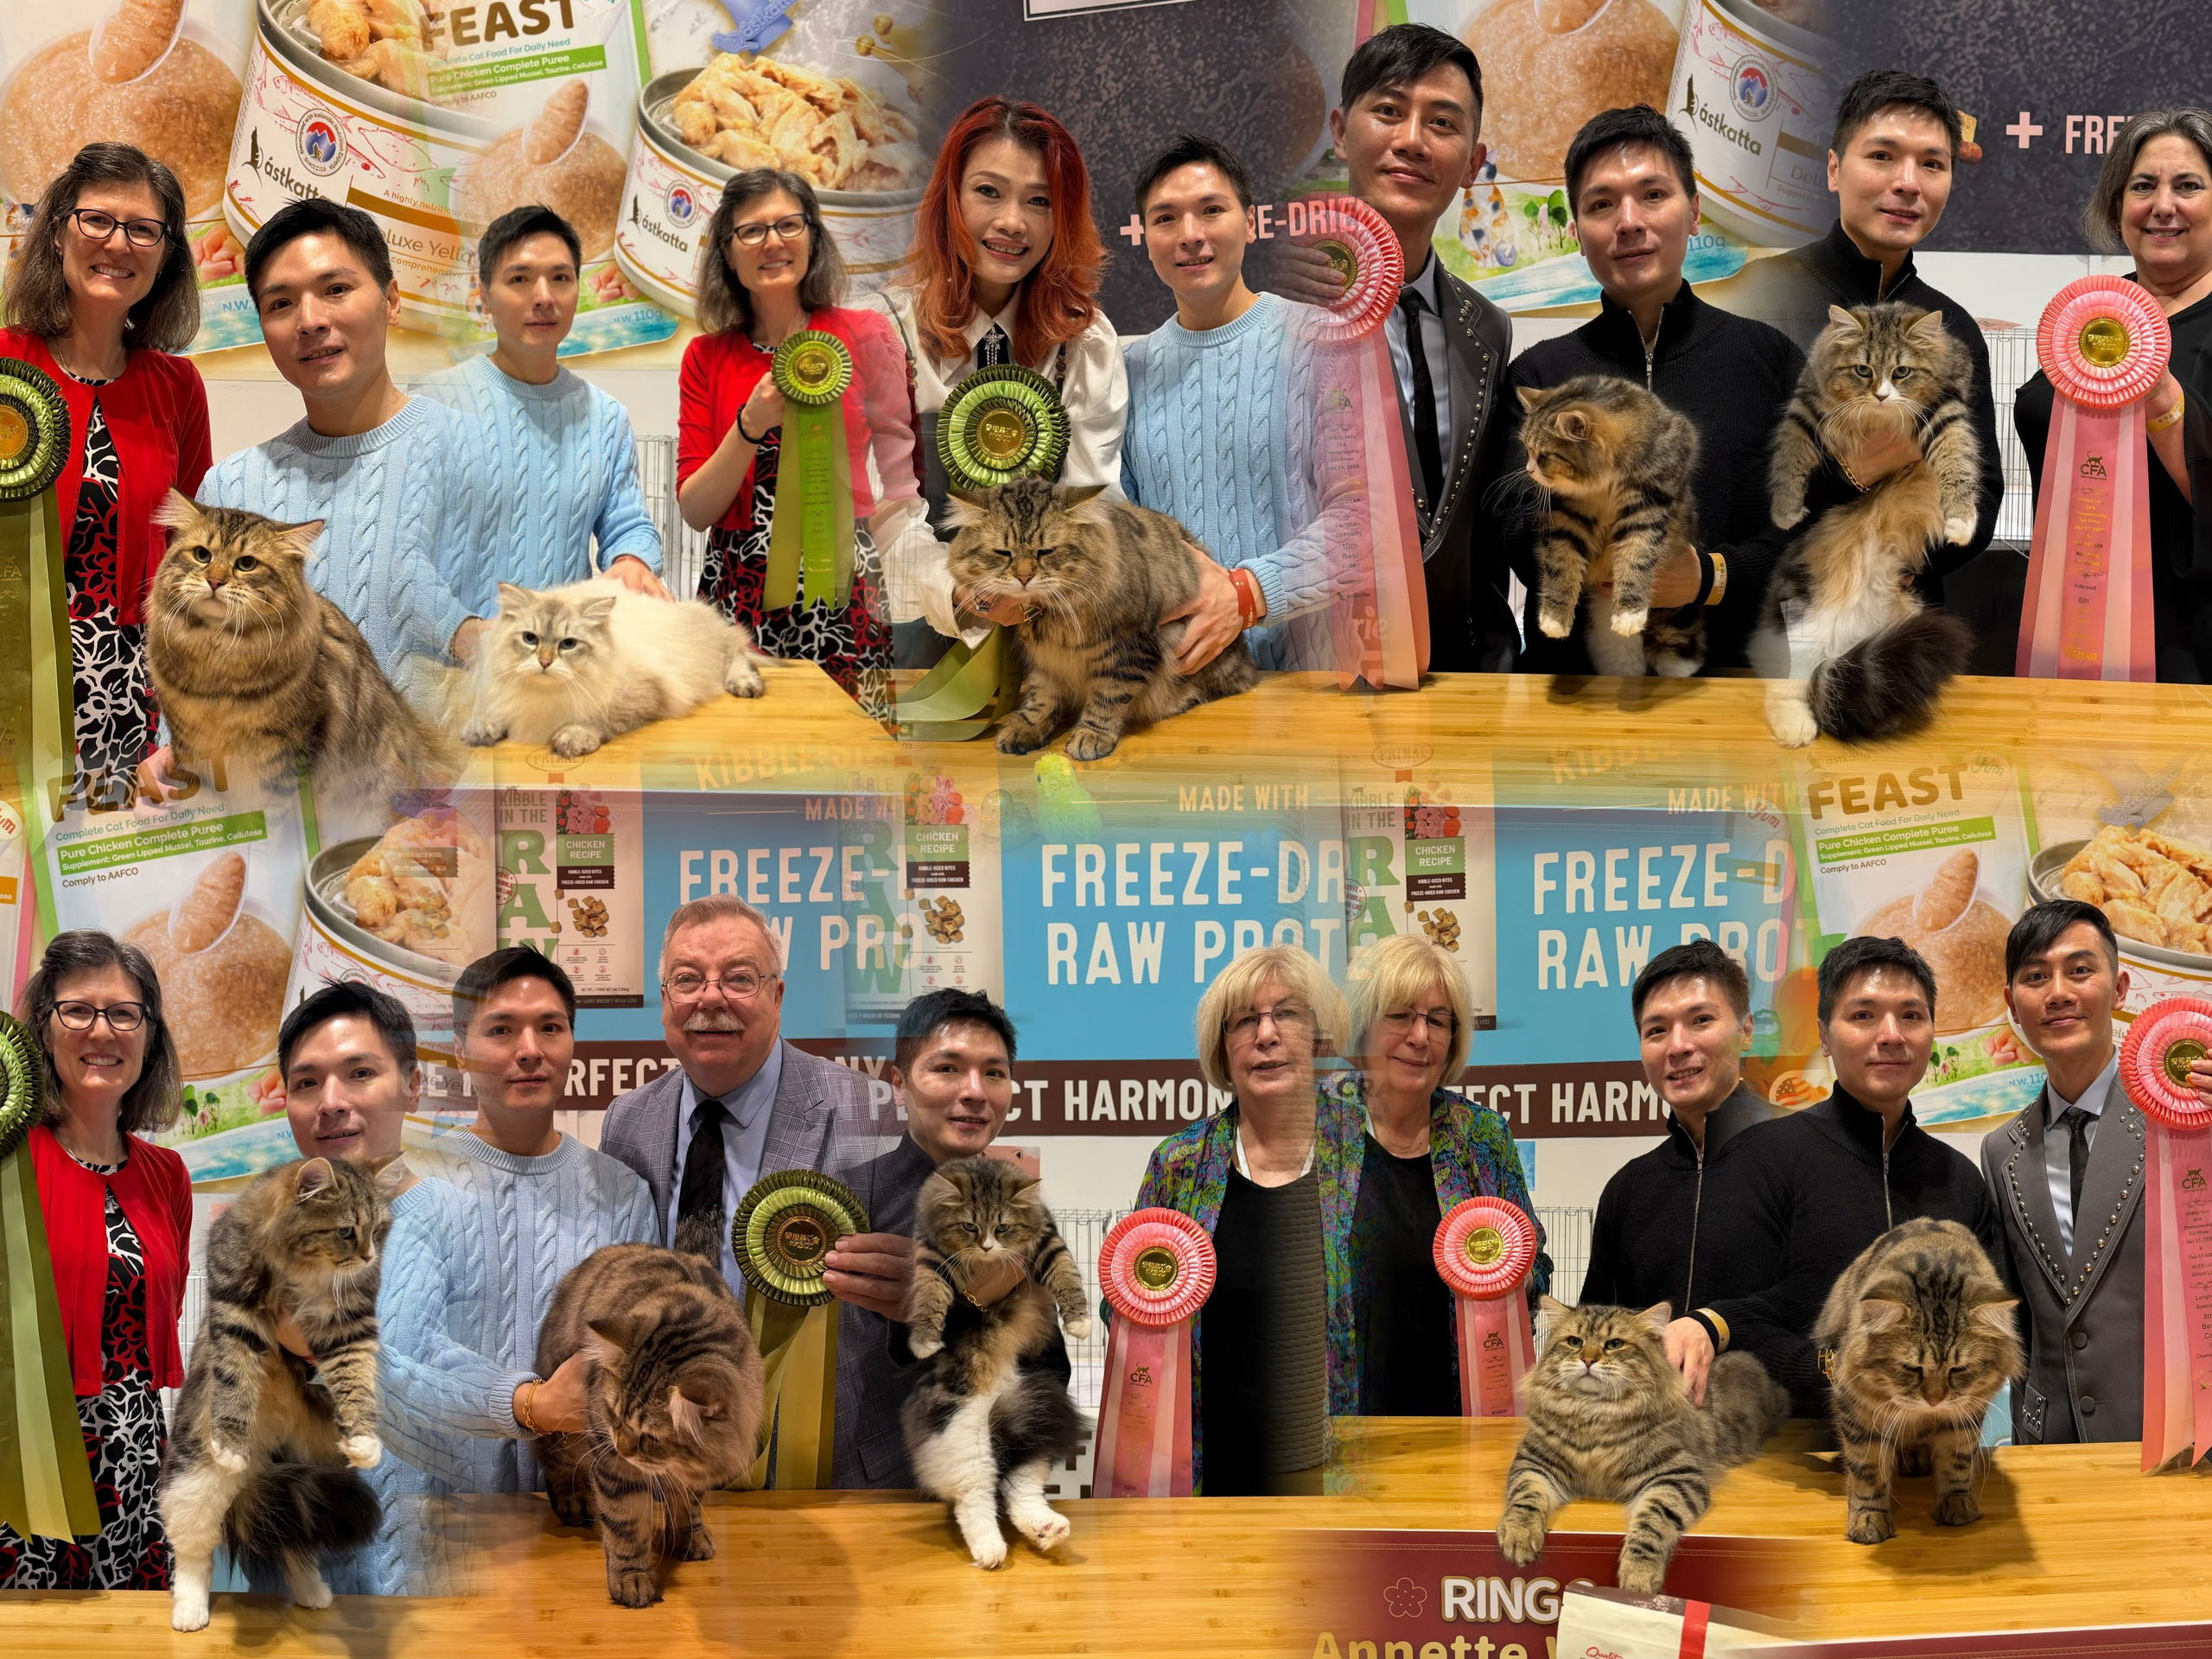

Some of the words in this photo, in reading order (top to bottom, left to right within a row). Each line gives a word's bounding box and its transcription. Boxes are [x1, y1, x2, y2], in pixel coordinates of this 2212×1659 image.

[420, 0, 574, 51] FEAST
[426, 56, 467, 68] Complete
[469, 52, 484, 61] Cat
[486, 48, 507, 58] Food
[509, 46, 522, 54] For
[524, 42, 545, 53] Daily
[548, 38, 570, 48] Need
[430, 73, 452, 83] Pure
[454, 64, 491, 79] Chicken
[493, 58, 540, 73] Complete
[542, 54, 569, 66] Puree
[474, 76, 494, 86] Green
[495, 73, 518, 84] Lipped
[572, 60, 603, 70] Cellulose
[471, 91, 497, 101] AAFCO
[1700, 103, 1762, 156] ástkatta
[2065, 115, 2133, 154] FRE
[391, 191, 417, 207] highly
[420, 201, 461, 216] nutritious
[1254, 199, 1357, 240] E-DRIE
[642, 215, 688, 252] ástkatta
[391, 257, 463, 279] comprehensive
[2080, 464, 2107, 476] CFA
[2075, 652, 2097, 660] ZERO
[1379, 746, 1426, 760] PRIMAL
[499, 792, 547, 806] KIBBLE
[1178, 785, 1244, 812] MADE
[1255, 784, 1309, 810] WITH
[1345, 792, 1395, 811] KIBBLE
[1668, 785, 1732, 815] MADE
[1807, 763, 1968, 821] FEAST
[55, 826, 104, 842] Complete
[105, 822, 124, 833] Cat
[126, 817, 150, 829] Food
[153, 813, 168, 824] For
[171, 808, 196, 820] Daily
[198, 803, 225, 816] Need
[499, 810, 513, 823] IN
[520, 809, 547, 823] THE
[805, 798, 865, 821] MADE
[1347, 813, 1361, 830] IN
[1367, 811, 1395, 829] THE
[1815, 823, 1856, 836] Complete
[1858, 821, 1873, 830] Cat
[1876, 817, 1897, 827] Food
[1914, 812, 1935, 823] Daily
[1937, 809, 1960, 818] Need
[60, 848, 86, 860] Pure
[88, 837, 132, 855] Chicken
[135, 830, 188, 849] Complete
[191, 823, 224, 836] Puree
[566, 840, 605, 849] CHICKEN
[916, 832, 959, 842] CHICKEN
[920, 844, 956, 854] RECIPE
[1415, 845, 1455, 855] CHICKEN
[1819, 842, 1840, 851] Pure
[1843, 834, 1881, 848] Chicken
[1883, 829, 1929, 842] Complete
[1931, 825, 1959, 835] Puree
[1821, 849, 1863, 861] Supplement:
[1864, 845, 1884, 855] Green
[1885, 842, 1908, 852] Lipped
[1909, 838, 1934, 848] Mussel,
[1962, 830, 1992, 841] Cellulose
[62, 856, 111, 872] Supplement:
[112, 851, 136, 862] Green
[137, 847, 163, 860] Lipped
[165, 842, 194, 853] Mussel,
[227, 829, 263, 842] Cellulose
[1420, 856, 1452, 867] RECIPE
[62, 874, 95, 889] Comply
[97, 874, 106, 882] to
[108, 868, 138, 880] AAFCO
[1821, 863, 1849, 874] Comply
[1860, 859, 1887, 868] AAFCO
[1047, 921, 1166, 985] RAW
[1538, 925, 1652, 990] RAW
[1064, 1078, 1234, 1122] HARMON
[1552, 1080, 1671, 1123] HARM
[2182, 1177, 2207, 1189] CFA
[1484, 1338, 1503, 1349] CFA
[1130, 1372, 1153, 1384] CFA
[1442, 1576, 1560, 1623] RING
[1313, 1631, 1528, 1659] Annette
[1586, 1647, 1623, 1659] Qualit
